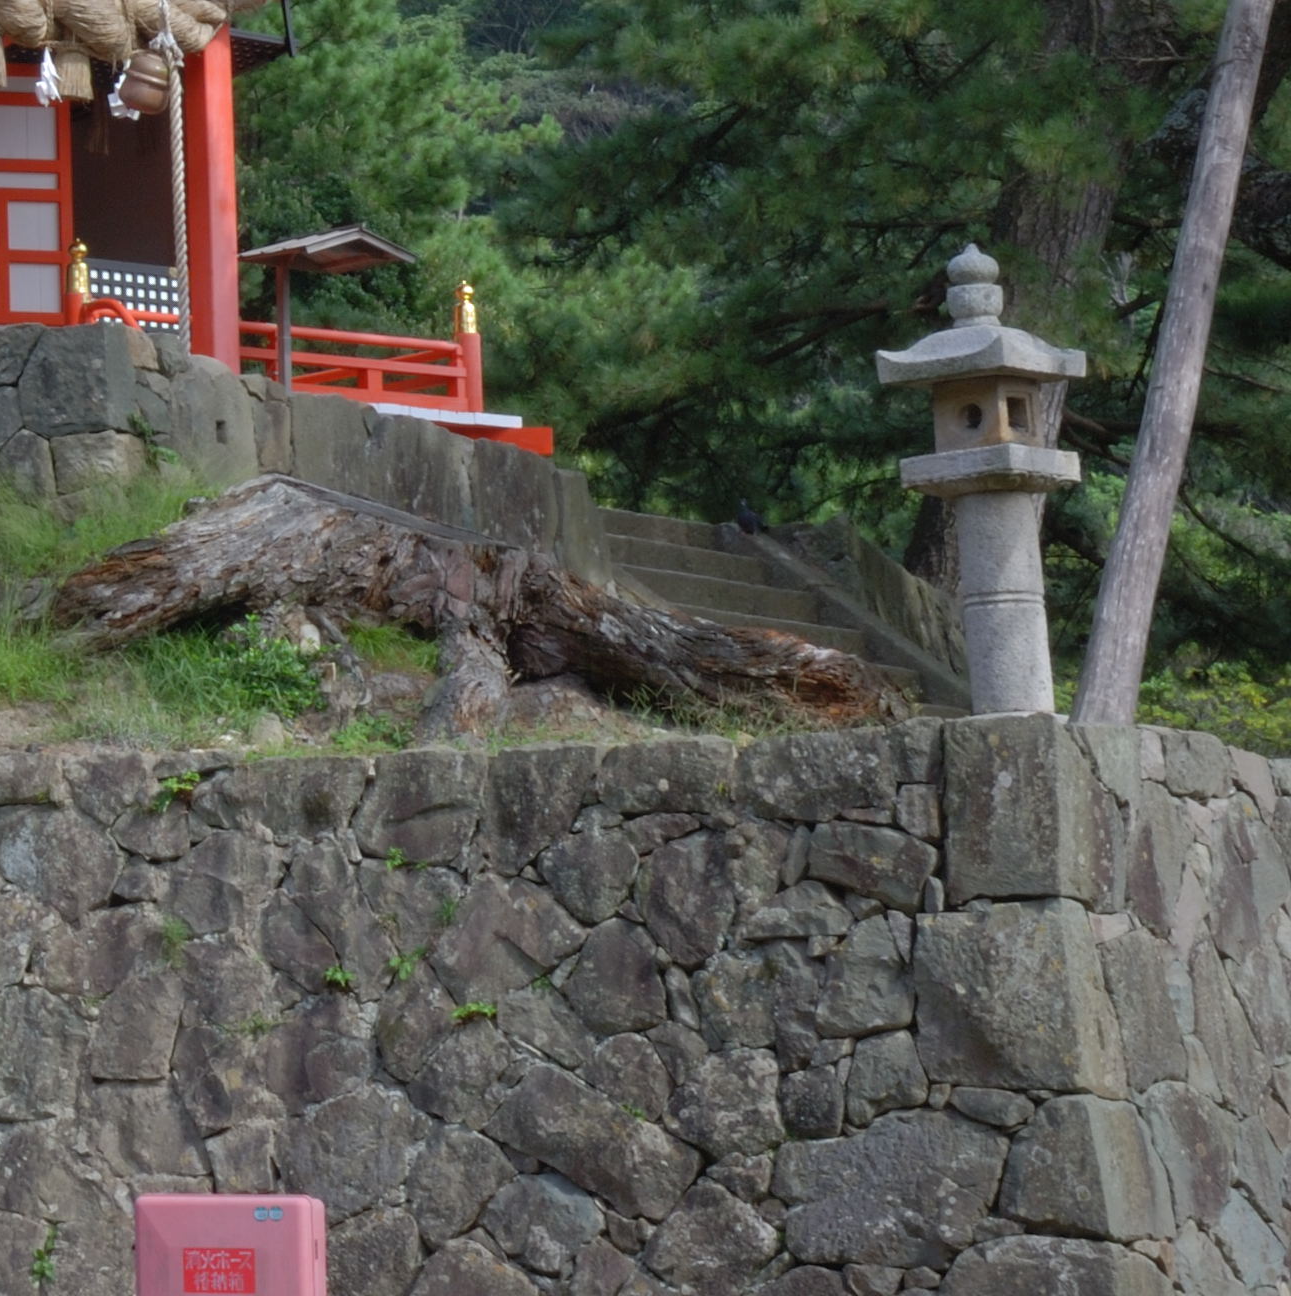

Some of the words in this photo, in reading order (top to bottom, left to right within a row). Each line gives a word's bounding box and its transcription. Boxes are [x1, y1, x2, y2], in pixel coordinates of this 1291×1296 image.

[185, 1249, 253, 1270] 消火ホース
[193, 1272, 245, 1292] 格納箱
